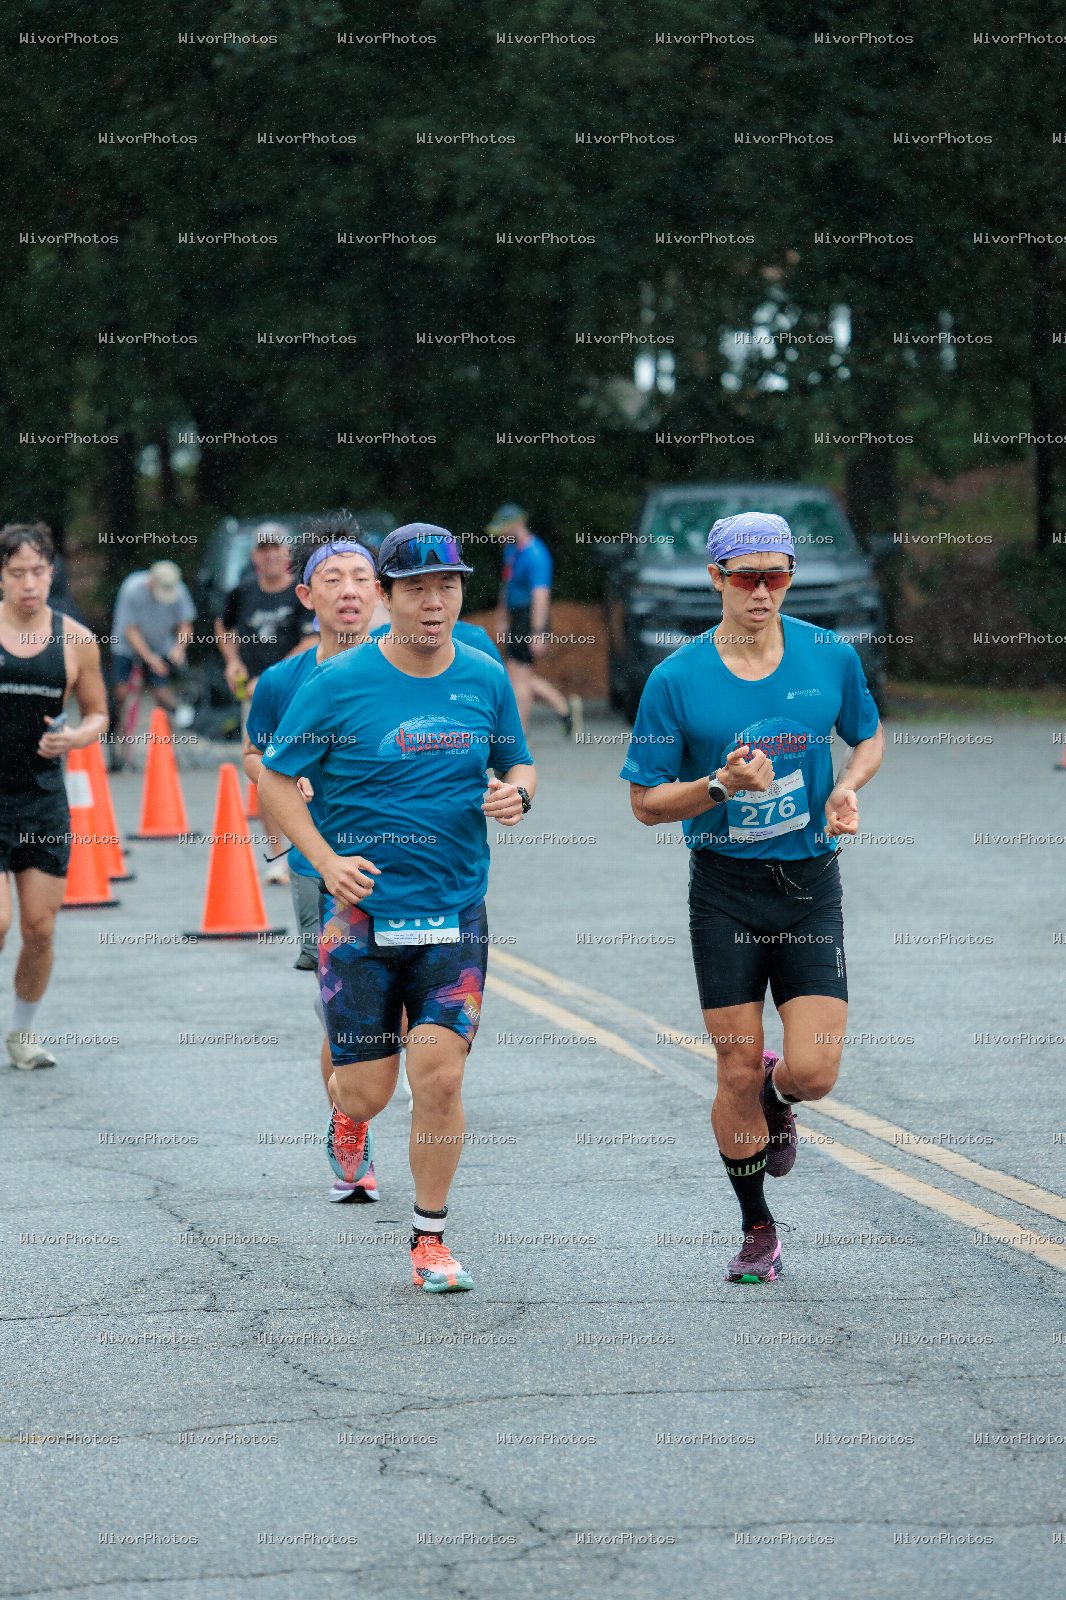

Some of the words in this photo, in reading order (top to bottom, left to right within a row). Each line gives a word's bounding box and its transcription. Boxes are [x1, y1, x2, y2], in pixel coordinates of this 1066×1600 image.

[407, 742, 470, 753] MARATHON
[783, 751, 806, 760] RELAY
[741, 796, 796, 826] 276
